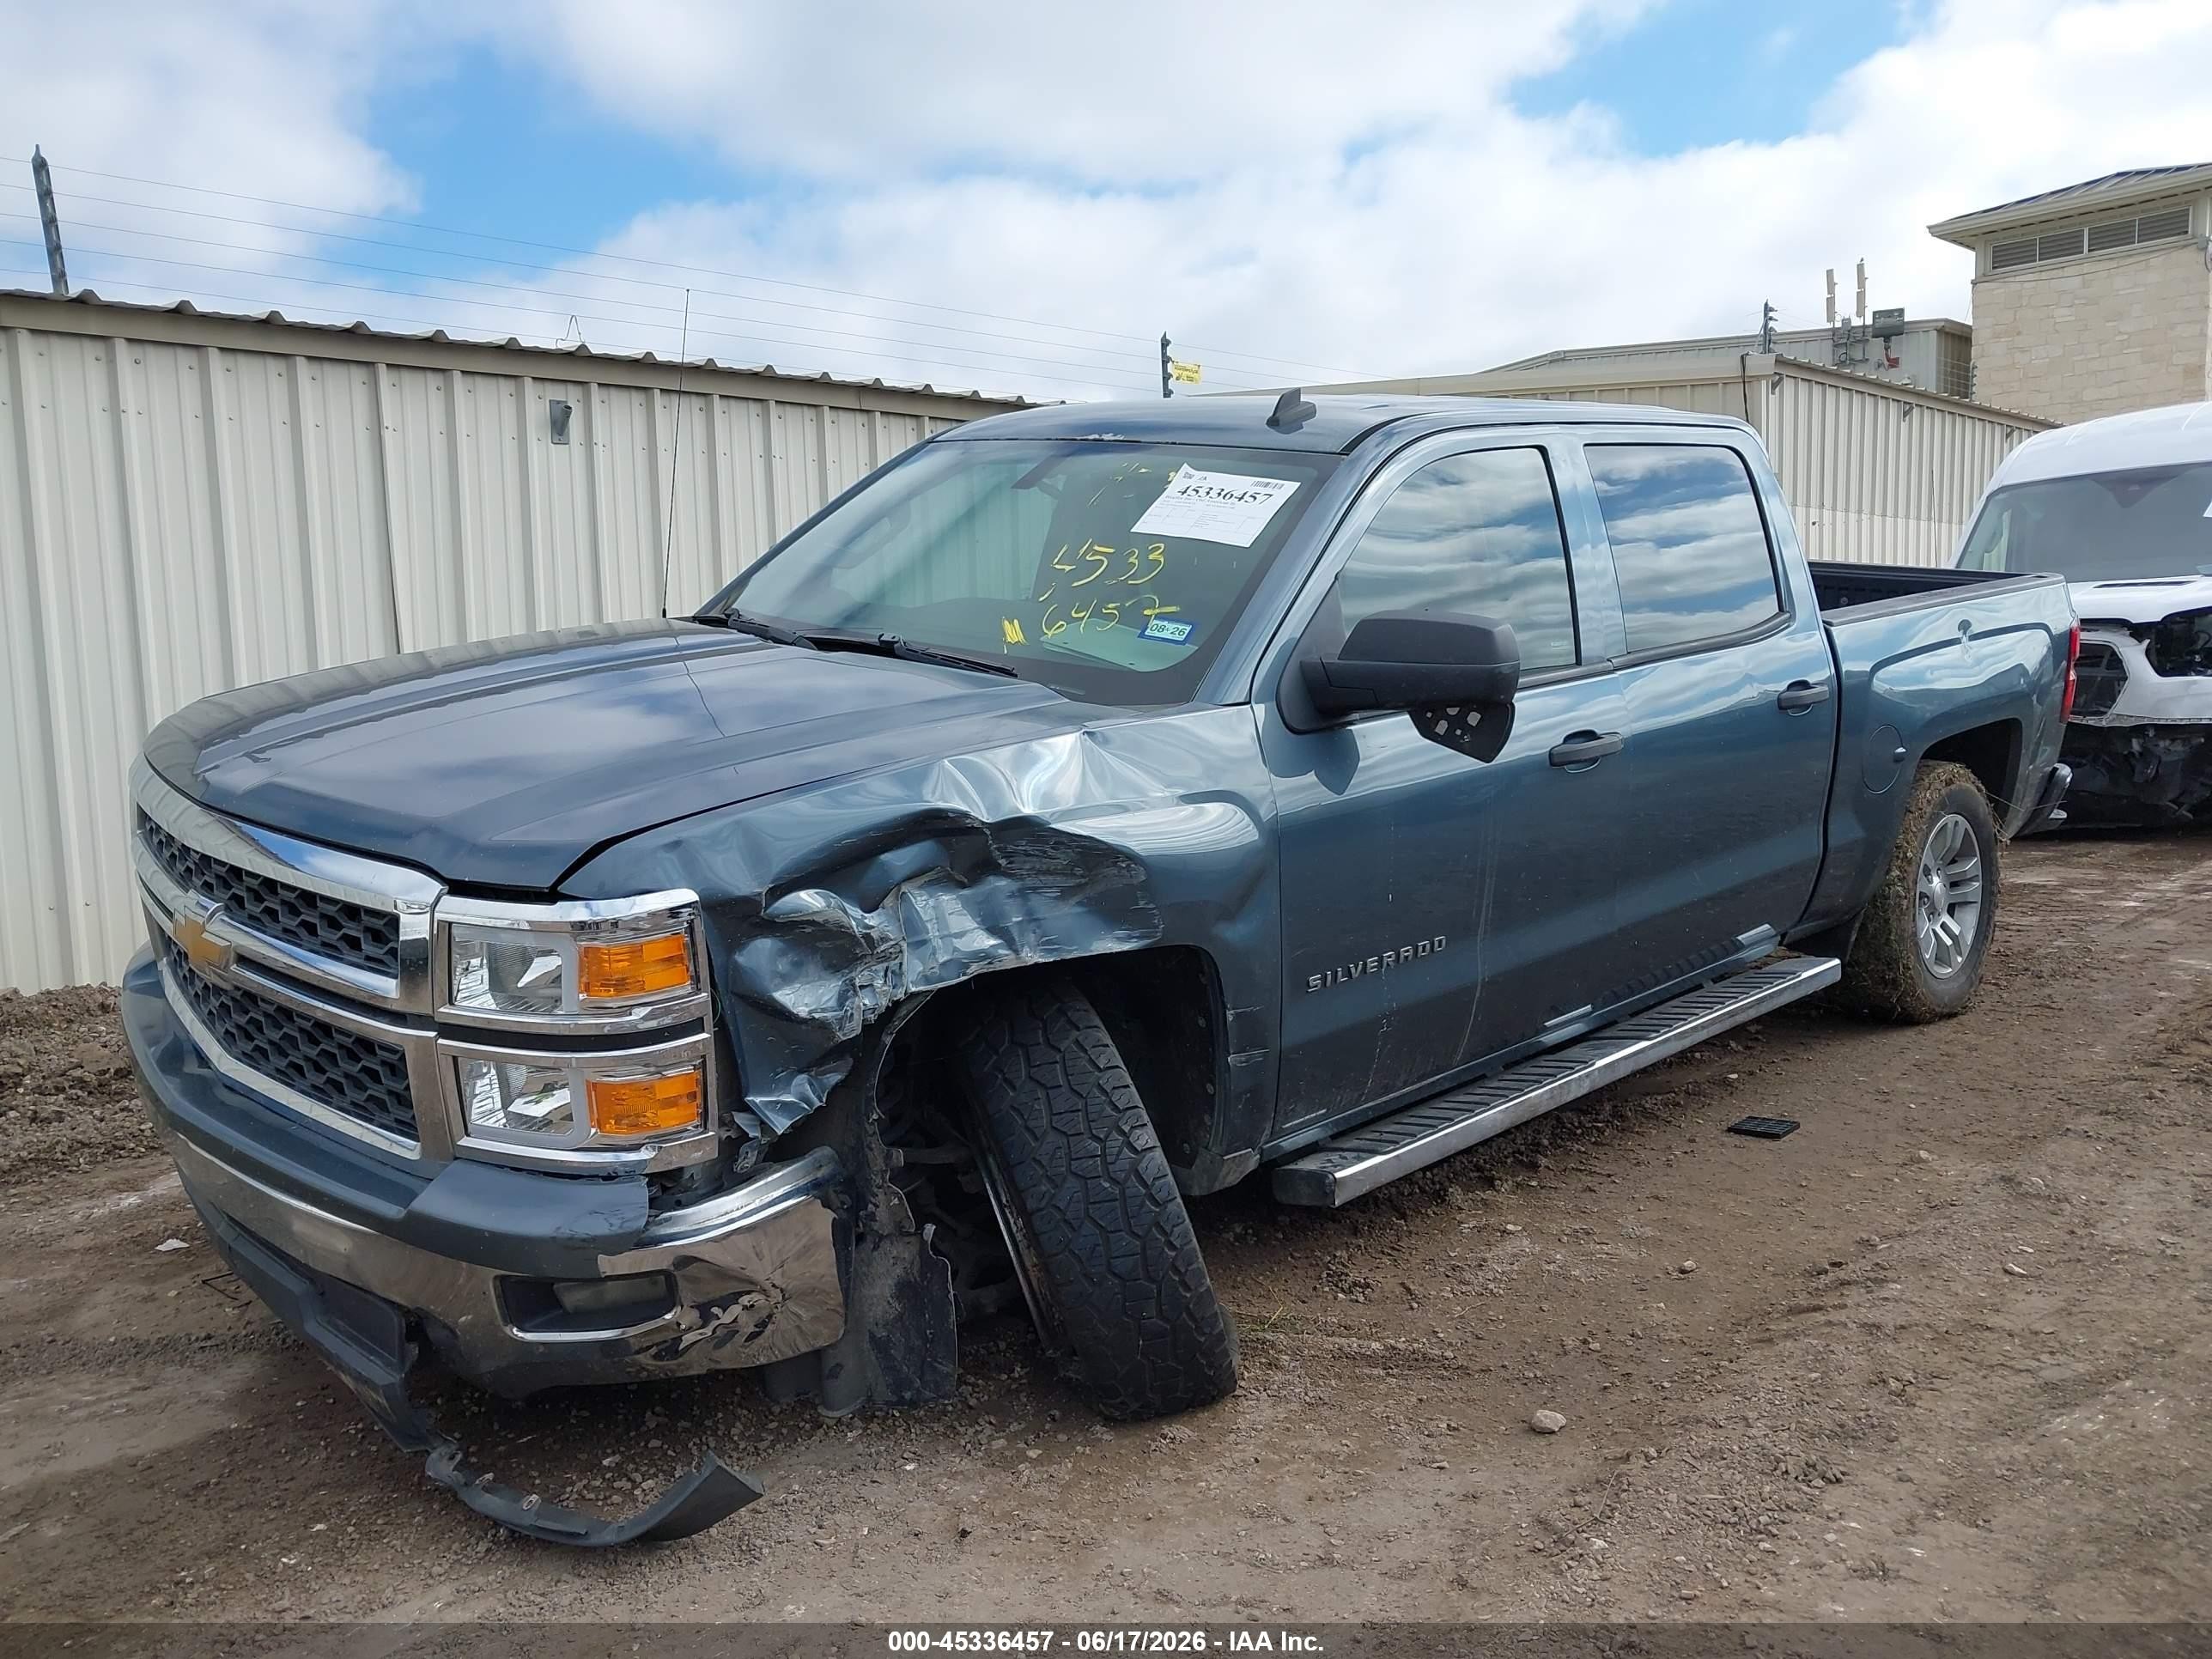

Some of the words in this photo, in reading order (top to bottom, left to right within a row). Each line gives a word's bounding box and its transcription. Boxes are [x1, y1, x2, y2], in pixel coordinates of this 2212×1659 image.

[1177, 484, 1273, 505] 45336457
[1050, 538, 1166, 588] 4533
[1042, 594, 1181, 639] 6457
[1149, 623, 1166, 633] 08
[1170, 626, 1188, 636] 26
[1306, 934, 1447, 994] SILVERADO
